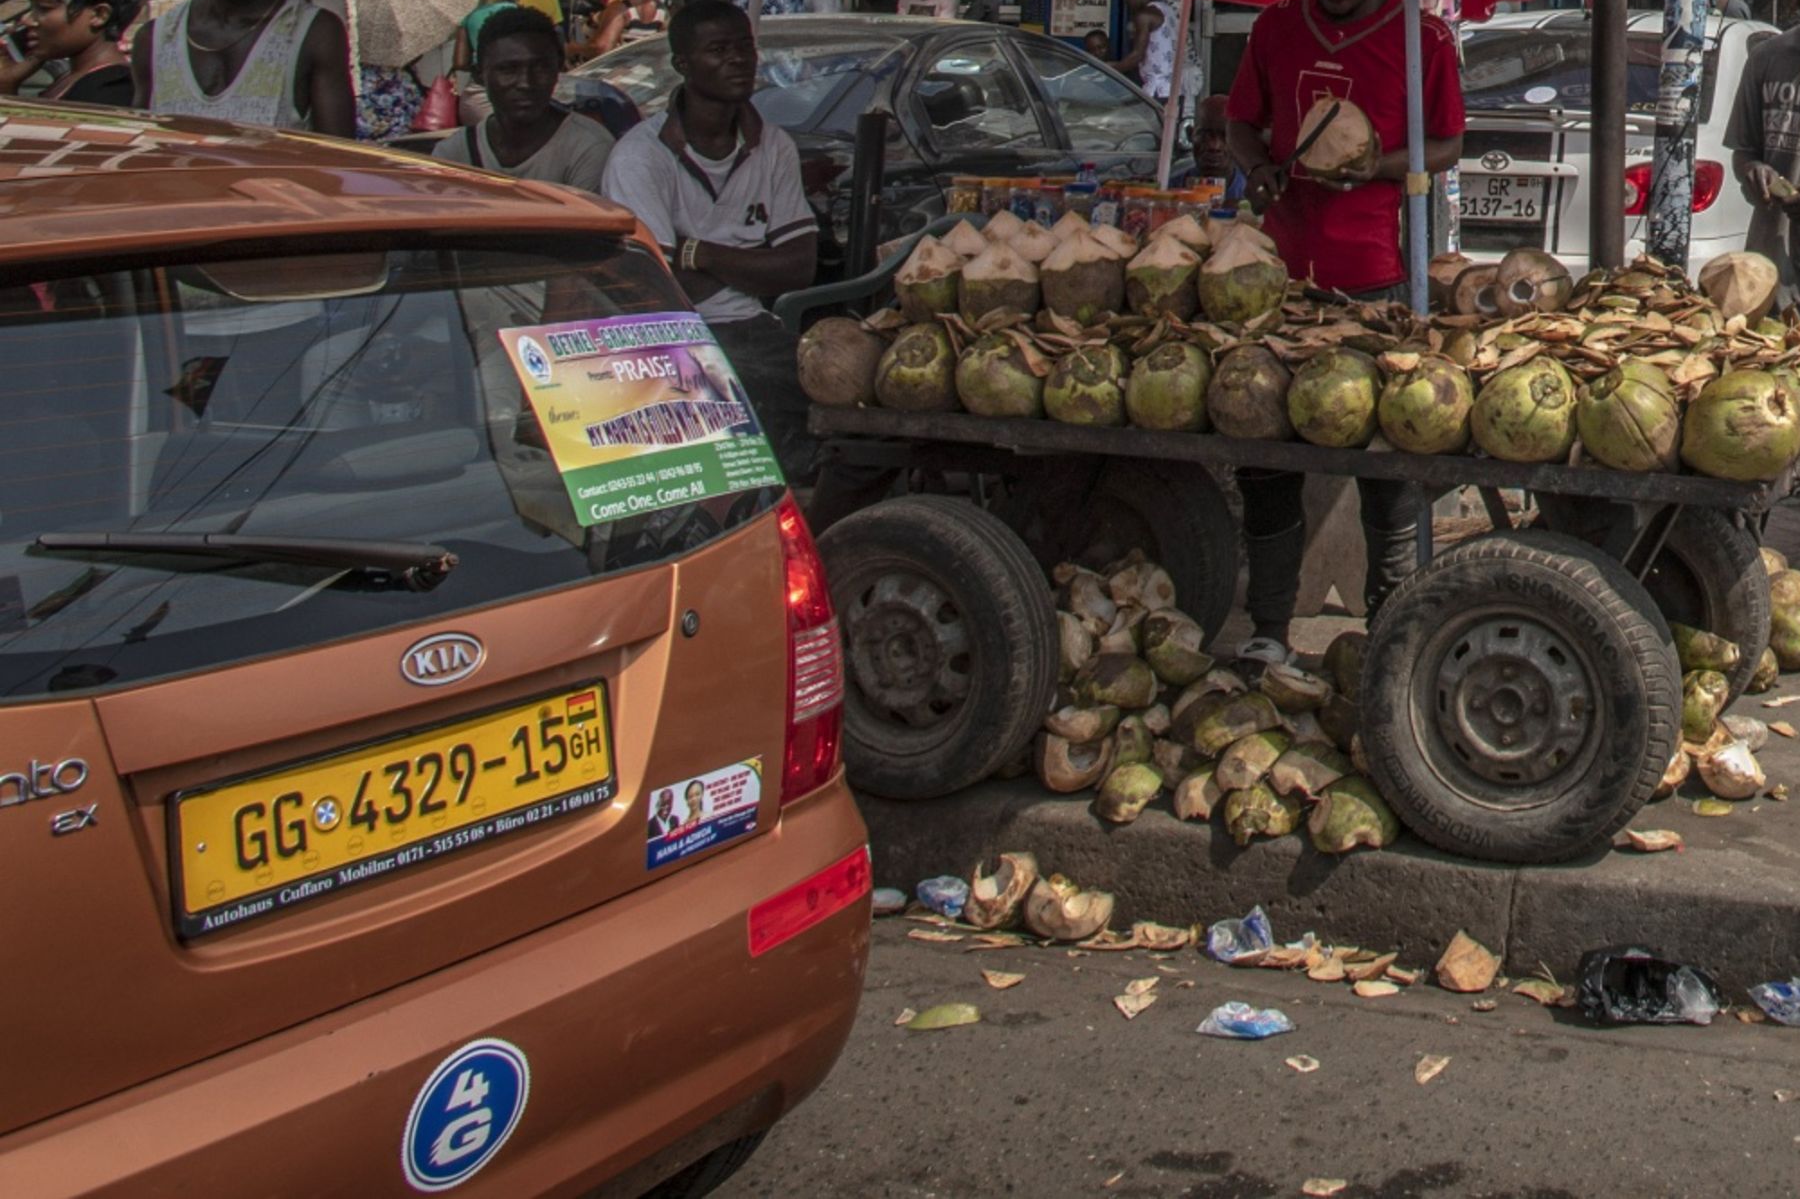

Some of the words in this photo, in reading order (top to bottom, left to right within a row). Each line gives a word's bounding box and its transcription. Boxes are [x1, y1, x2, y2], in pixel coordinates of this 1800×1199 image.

[1487, 177, 1510, 197] GR
[590, 499, 628, 519] Come
[415, 643, 472, 678] KIA
[568, 725, 602, 760] GH
[232, 791, 308, 872] GG
[349, 716, 570, 836] 4329-15
[50, 802, 101, 837] EX
[201, 895, 274, 931] Autohaus
[278, 876, 334, 906] Cuffaro
[338, 855, 396, 886] Mobilnr:
[396, 843, 426, 867] 0171
[495, 813, 525, 834] Büro
